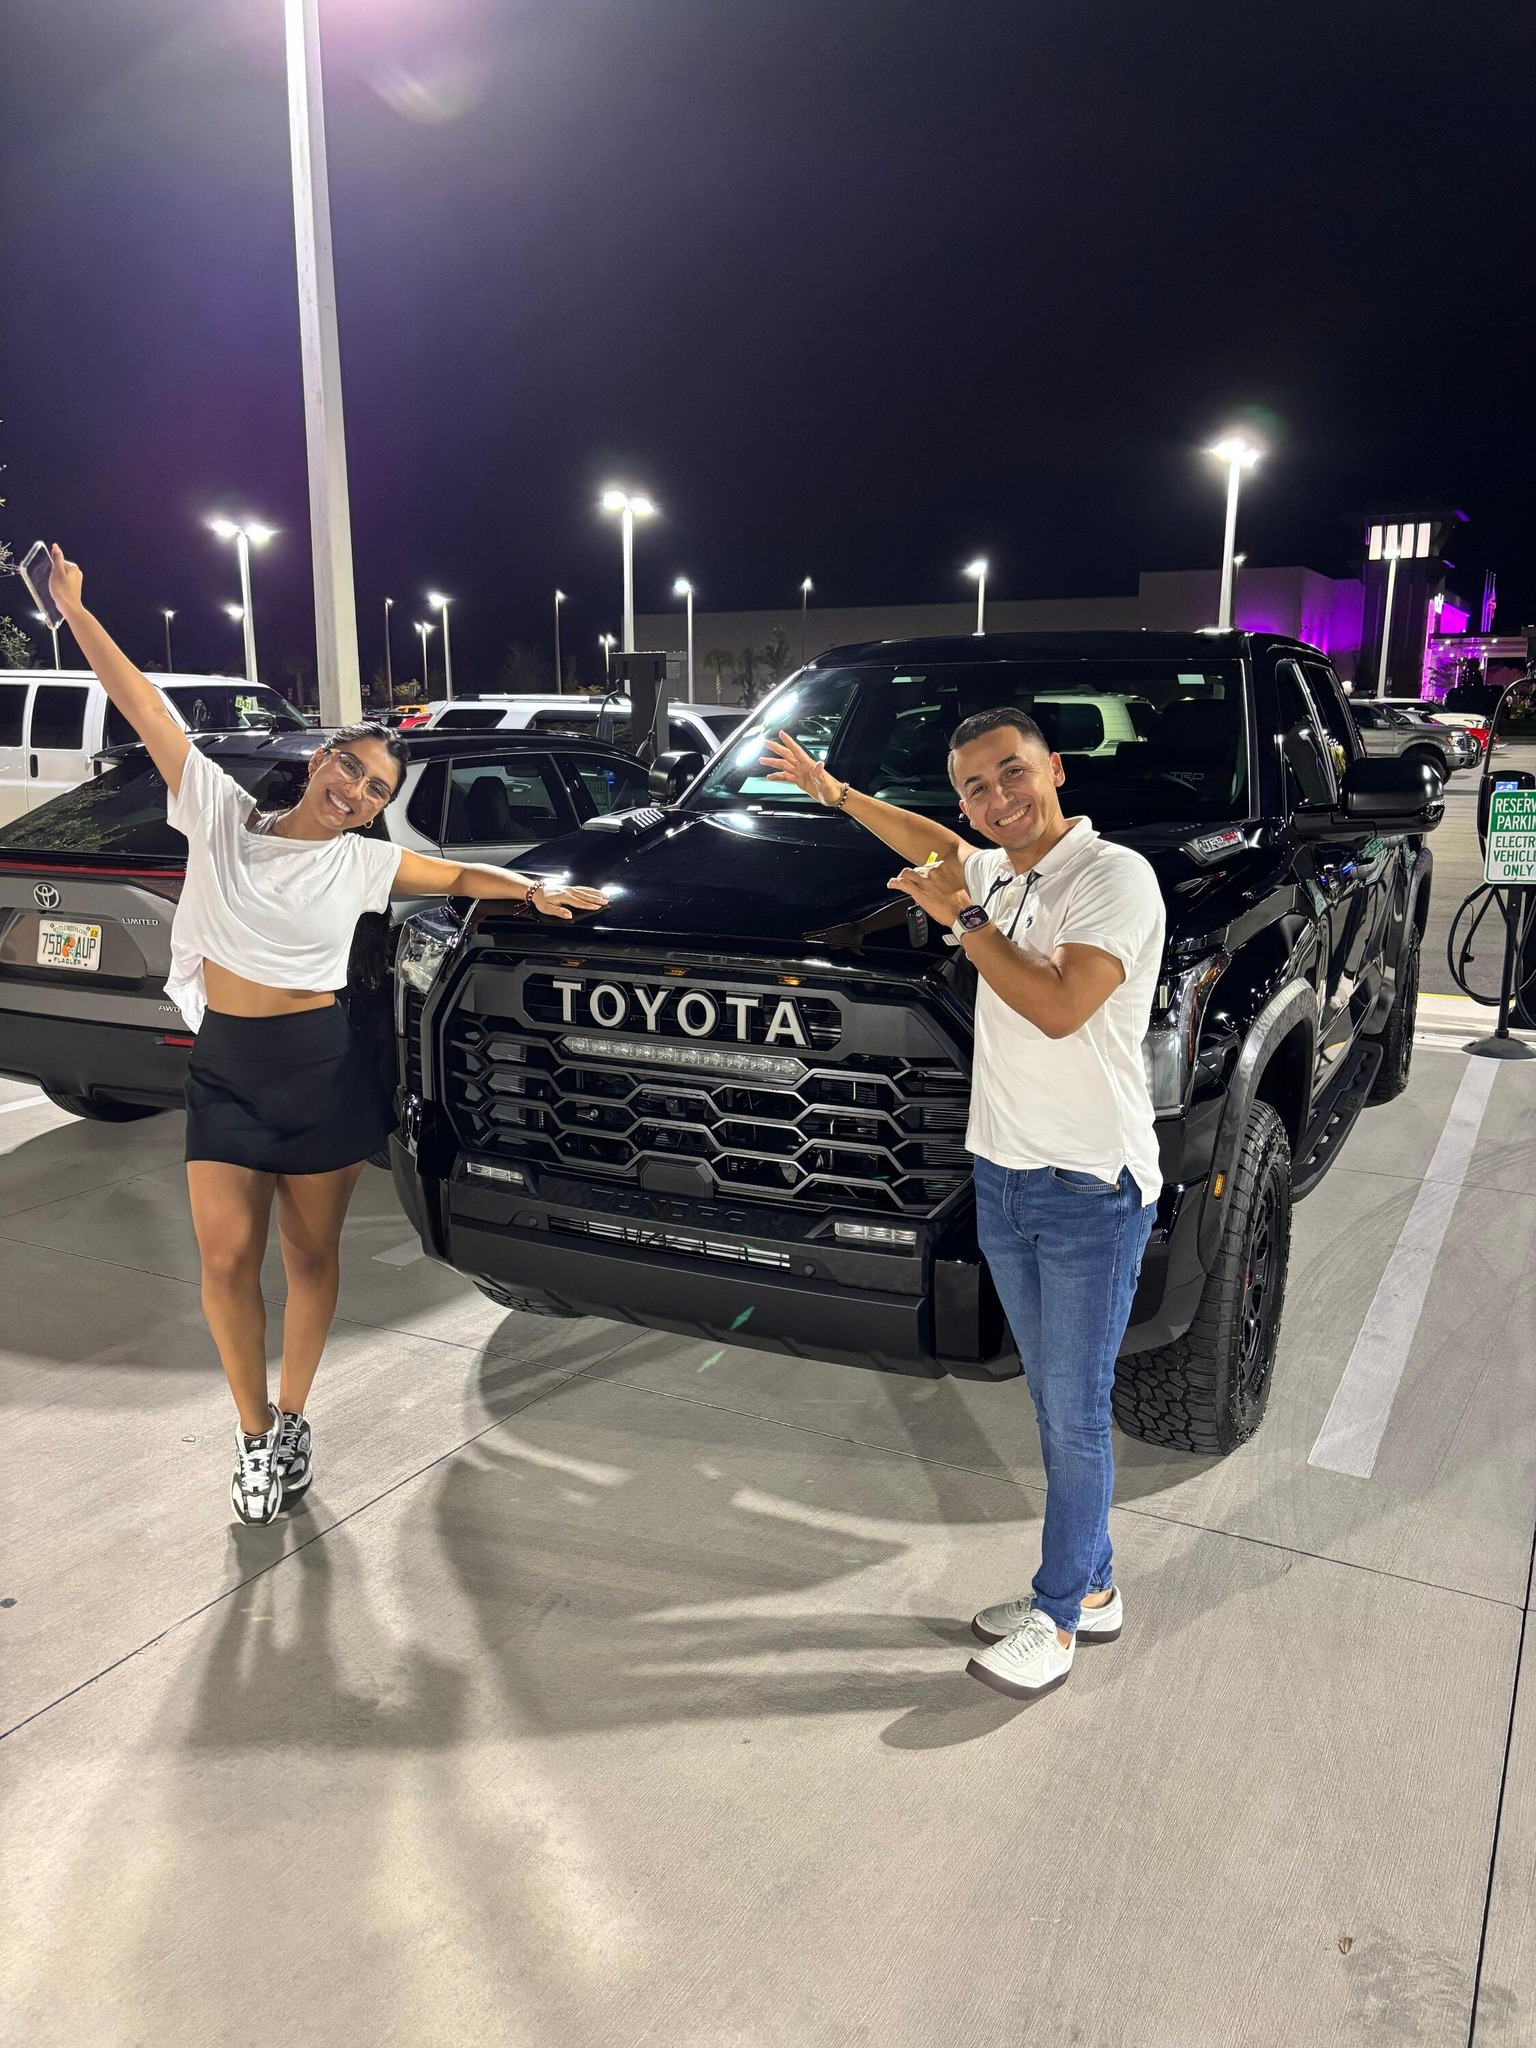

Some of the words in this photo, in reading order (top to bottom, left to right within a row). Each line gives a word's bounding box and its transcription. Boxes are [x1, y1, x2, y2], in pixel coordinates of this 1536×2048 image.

[1170, 772, 1204, 782] TRD
[1503, 864, 1534, 876] ONLY
[122, 917, 159, 926] LIMITED
[42, 933, 62, 956] 75B
[75, 937, 96, 959] AUP
[552, 976, 812, 1048] TOYOTA
